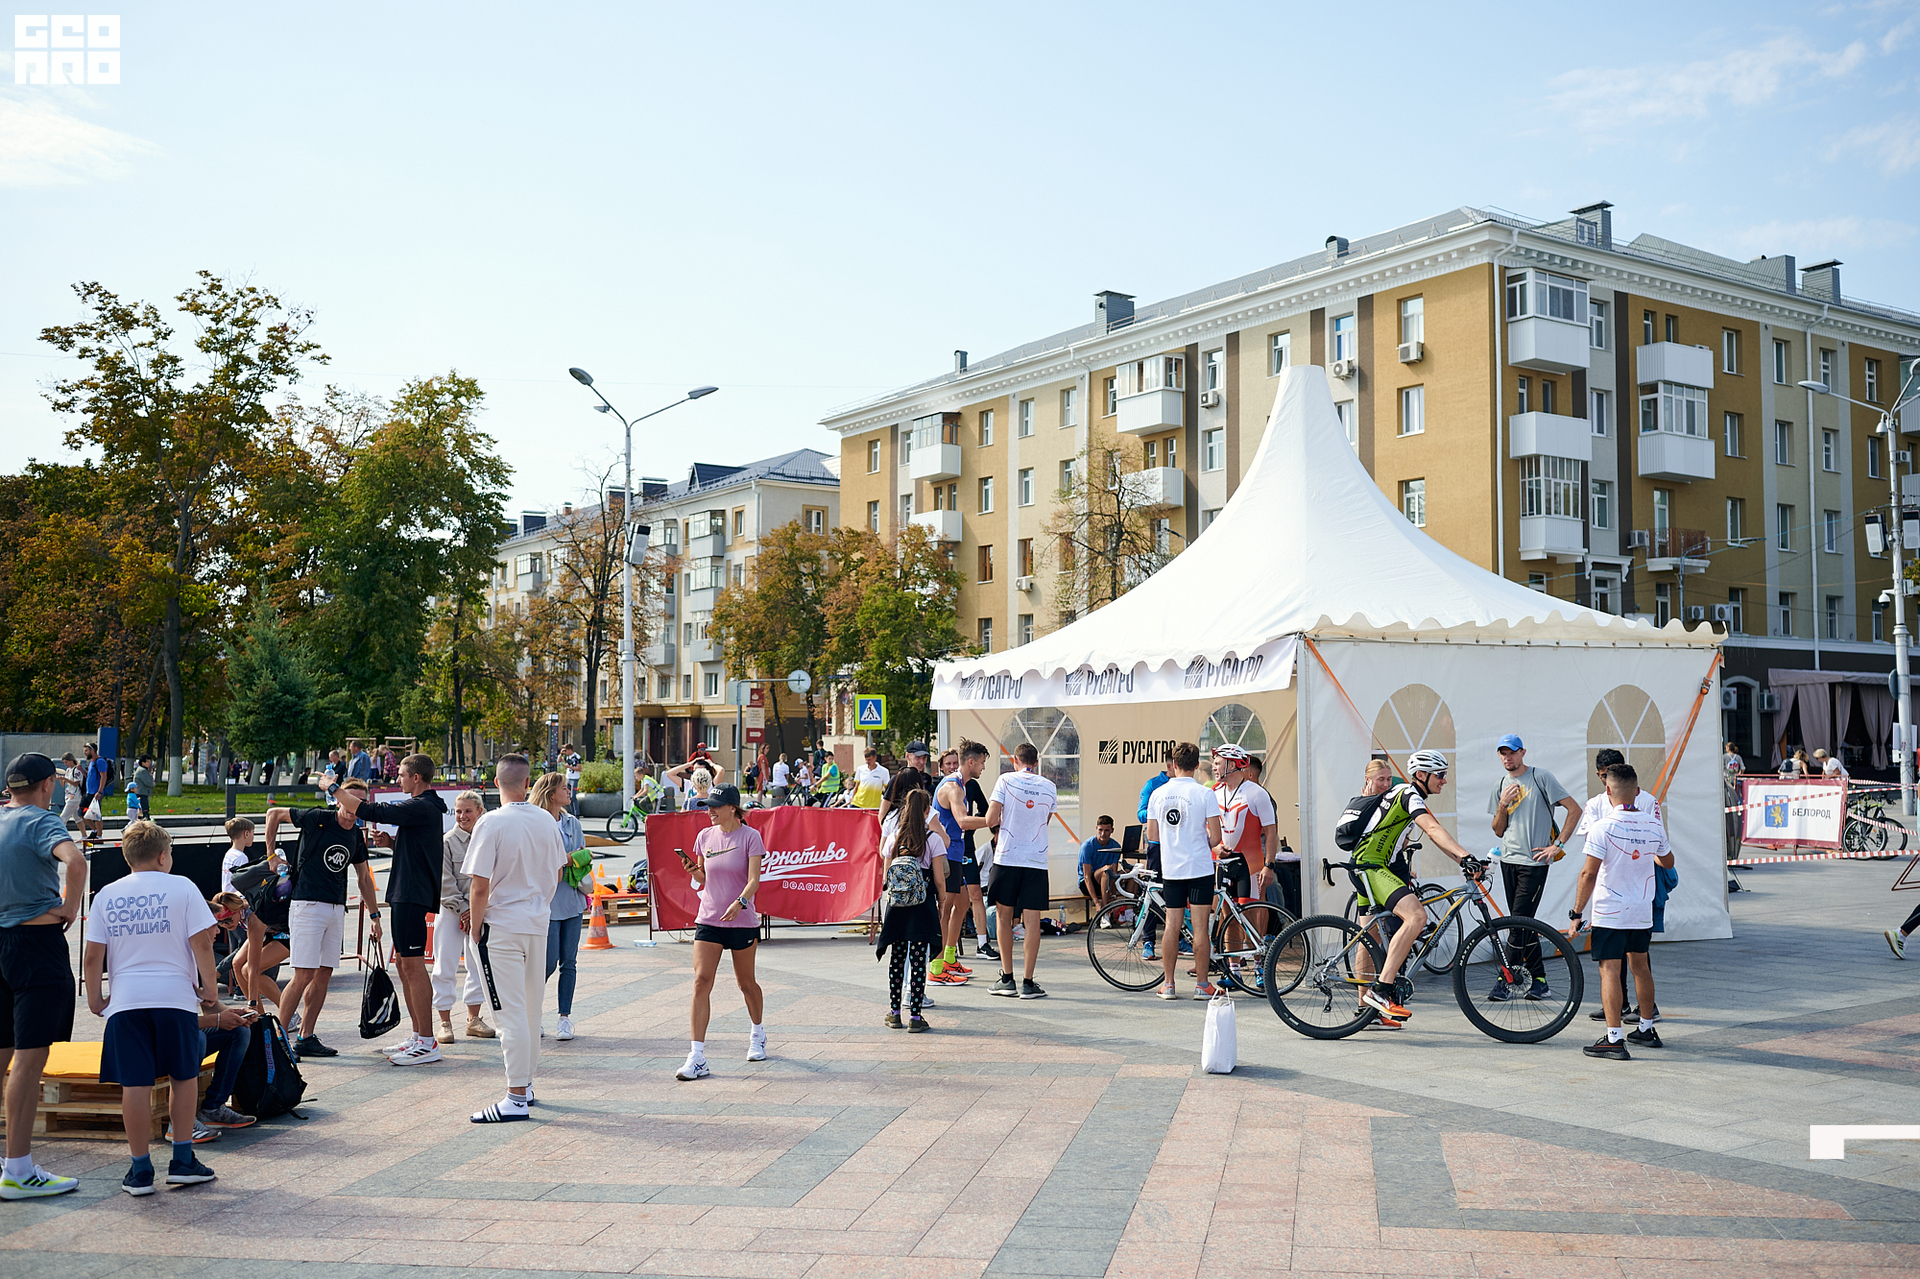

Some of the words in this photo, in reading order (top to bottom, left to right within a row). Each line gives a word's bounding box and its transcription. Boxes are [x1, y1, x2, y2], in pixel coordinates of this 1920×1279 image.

[1206, 655, 1264, 688] РУСАГРО
[974, 674, 1024, 700] РУСАГРО
[1792, 808, 1831, 819] БЕЛГОРОД
[105, 893, 167, 911] ДОРОГУ
[107, 906, 169, 924] ОСИЛИТ
[106, 920, 171, 937] БЕГУЩИЙ
[1459, 938, 1476, 967] MAXXIS
